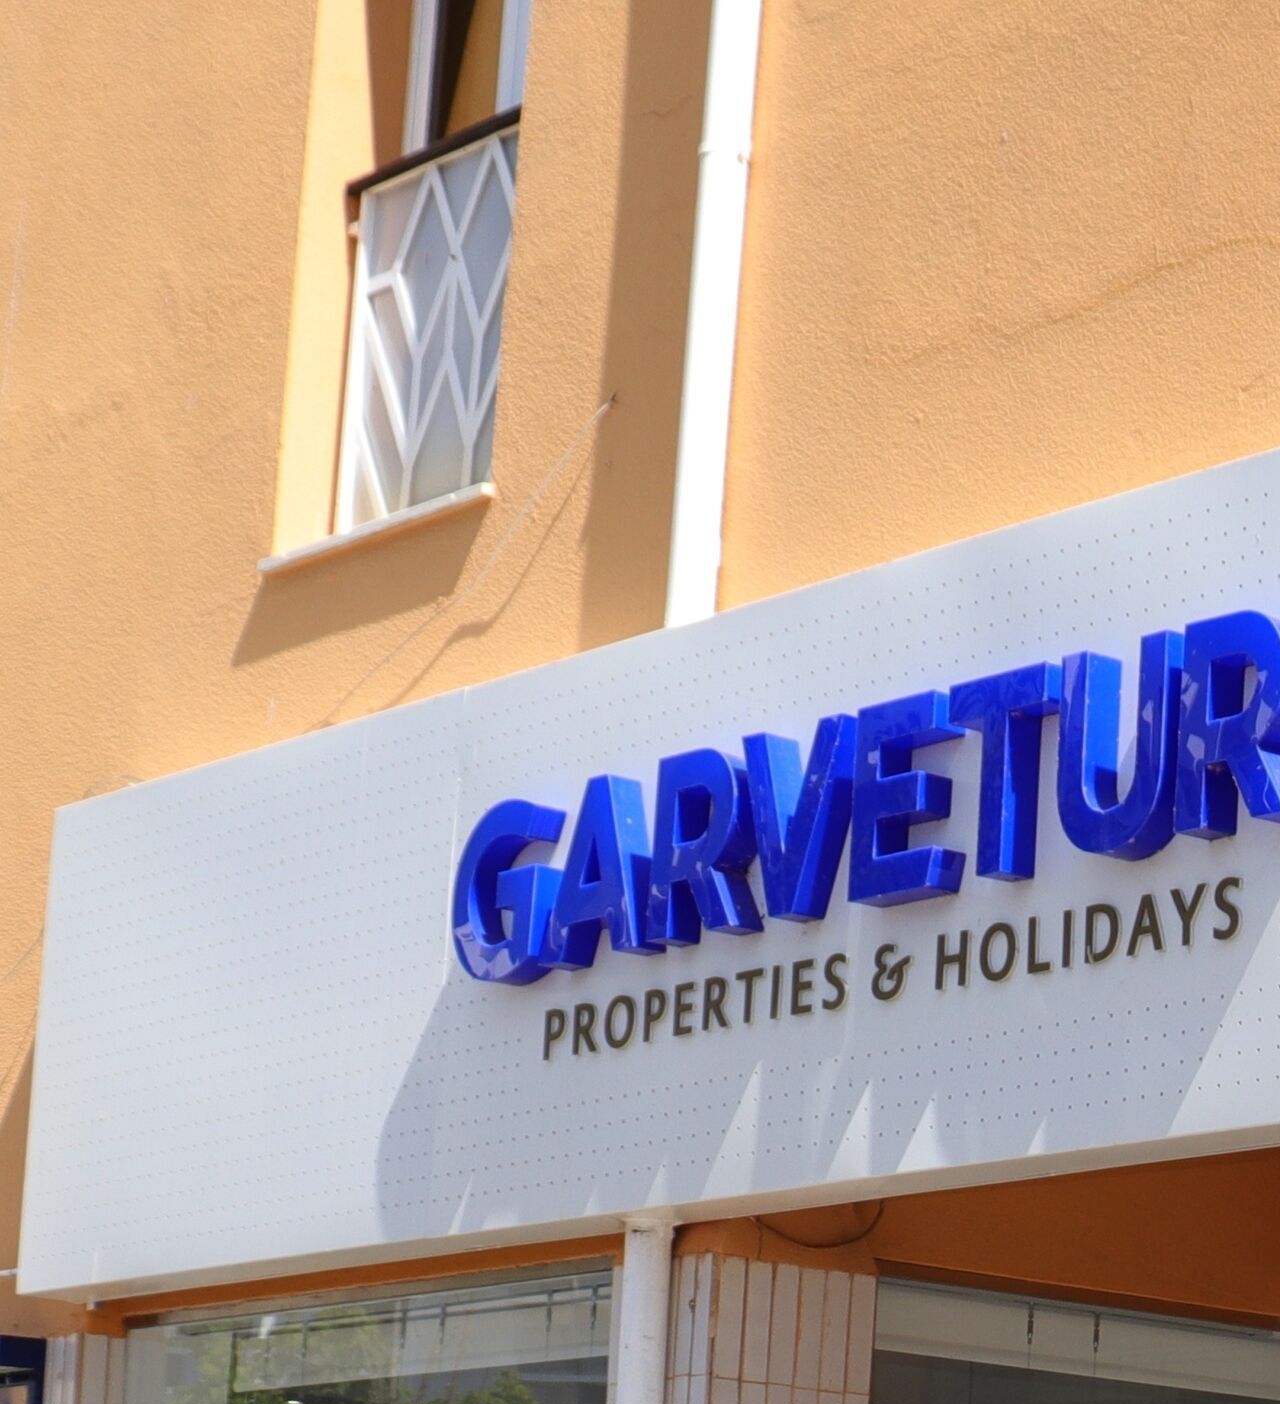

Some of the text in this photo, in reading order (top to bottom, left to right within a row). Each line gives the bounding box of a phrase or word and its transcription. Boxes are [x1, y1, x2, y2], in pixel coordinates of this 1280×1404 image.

[542, 876, 1242, 1061] PROPERTIES & HOLIDAYS
